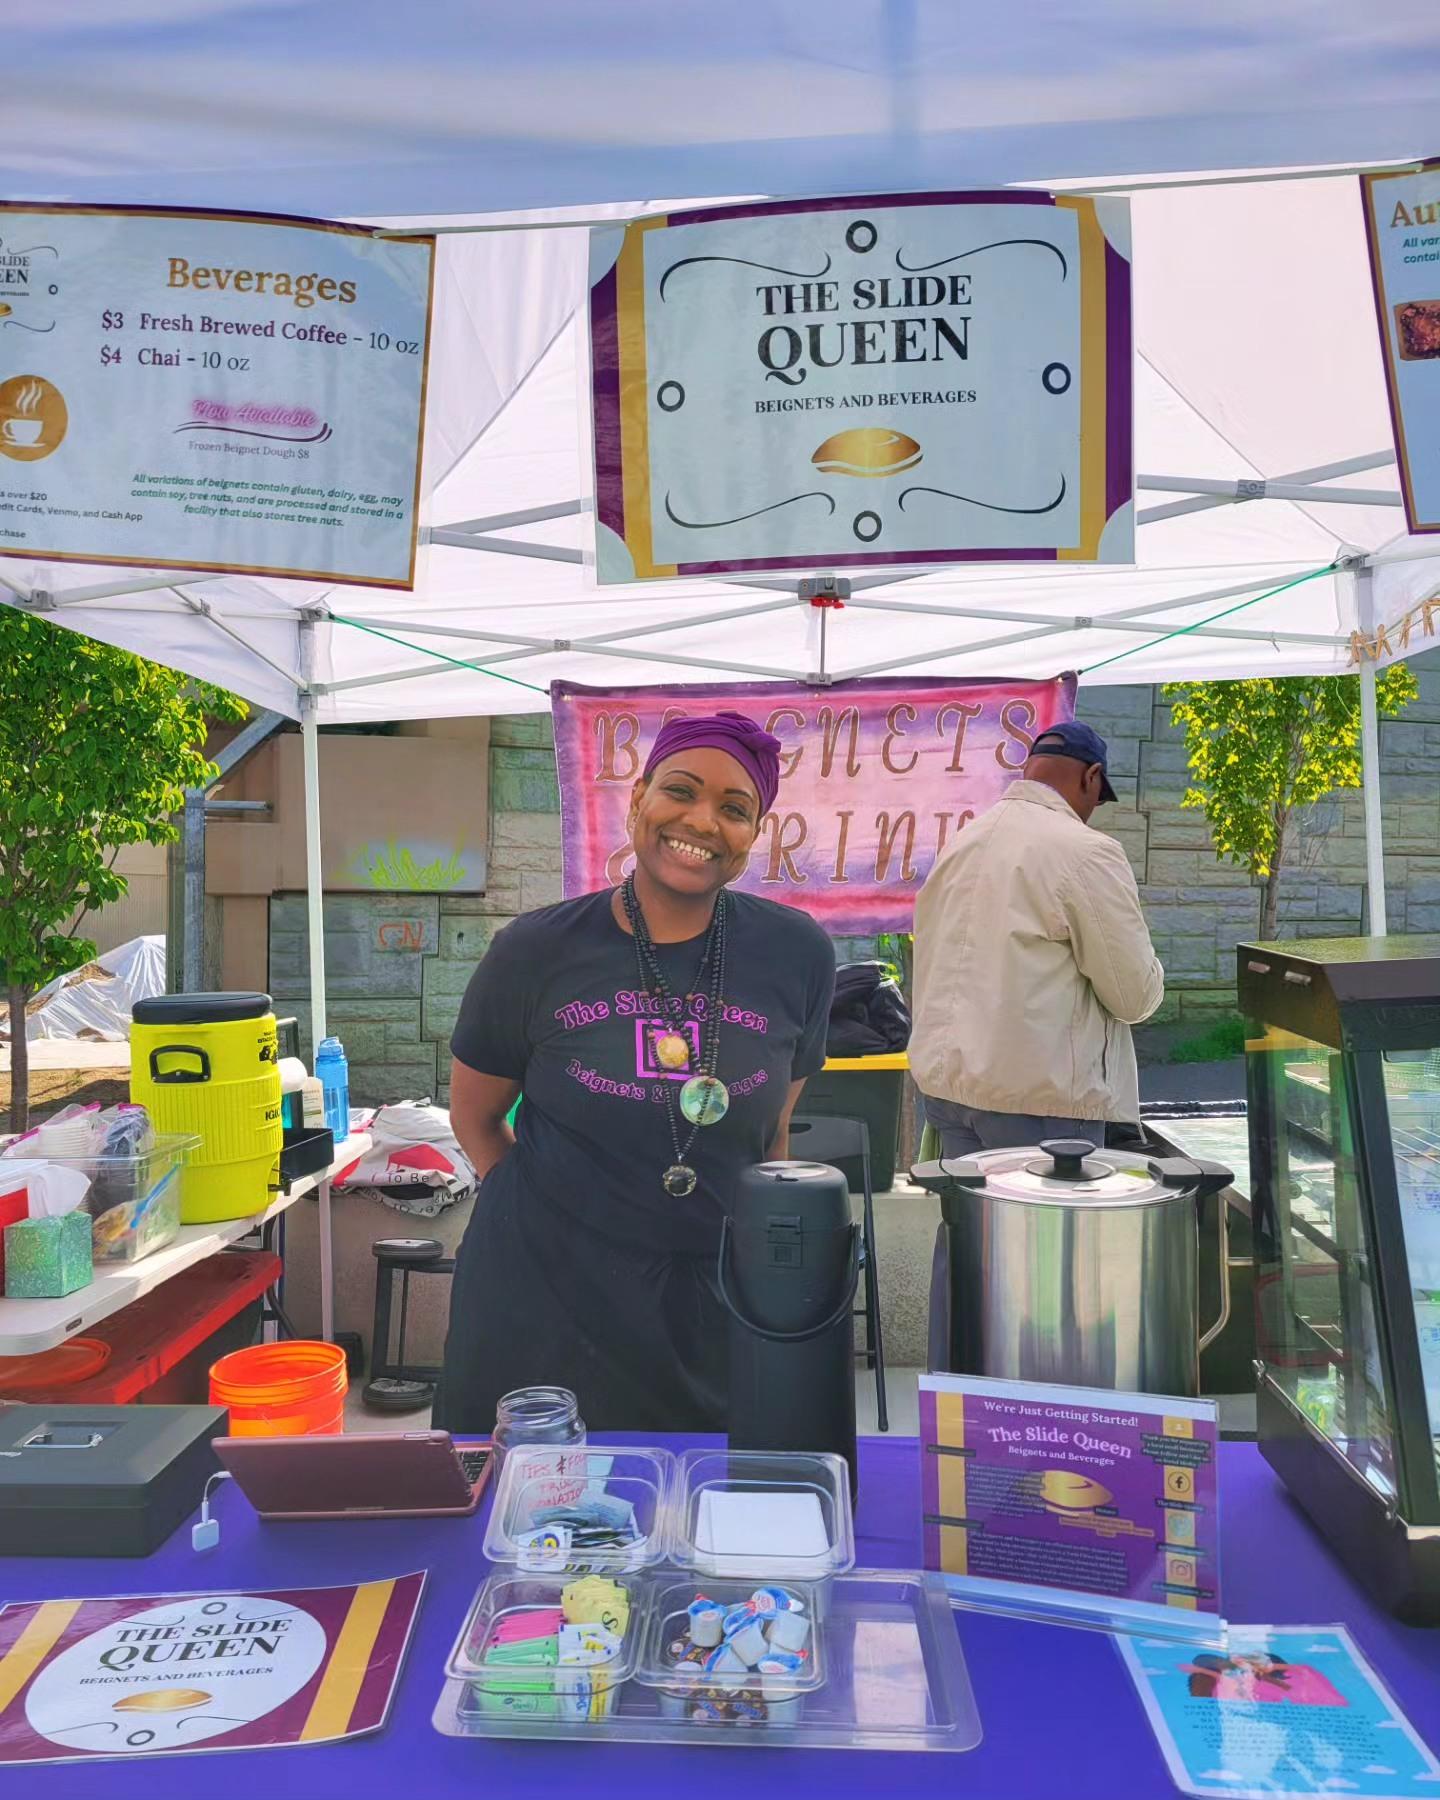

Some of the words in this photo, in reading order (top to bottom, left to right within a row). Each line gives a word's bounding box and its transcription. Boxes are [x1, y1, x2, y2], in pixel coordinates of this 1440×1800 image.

[1390, 199, 1440, 227] Au
[1402, 237, 1418, 248] All
[0, 255, 31, 267] LIDE
[167, 257, 357, 308] Beverages
[756, 281, 840, 316] THE
[852, 275, 972, 310] SLIDE
[101, 309, 124, 331] $3
[140, 313, 194, 332] Fresh
[200, 316, 275, 338] Brewed
[282, 322, 348, 345] Coffee
[369, 332, 390, 350] 10
[396, 340, 420, 355] oz
[100, 345, 122, 367] $4
[137, 348, 181, 366] Chai
[202, 351, 222, 369] 10
[227, 357, 250, 371] oz
[757, 316, 972, 386] QUEEN
[755, 396, 835, 414] BEIGNETS
[839, 394, 874, 409] AND
[878, 390, 977, 406] BEVERAGES
[188, 441, 222, 451] Frozen
[224, 443, 260, 456] Beignet
[263, 447, 296, 459] Dough
[30, 491, 48, 501] $20
[131, 489, 168, 498] contain
[190, 492, 209, 501] tree
[211, 493, 234, 503] nuts,
[237, 495, 256, 504] and
[257, 497, 274, 506] are
[275, 498, 327, 511] processed
[329, 503, 349, 514] and
[350, 505, 383, 517] stored
[385, 509, 394, 518] in
[132, 474, 146, 483] All
[148, 475, 194, 486] variations
[197, 478, 208, 487] of
[208, 479, 250, 490] beignets
[251, 482, 290, 493] contain
[291, 485, 326, 498] gluten,
[327, 488, 356, 502] dairy,
[381, 496, 403, 508] may
[0, 503, 14, 511] dit
[16, 504, 45, 515] Cards,
[48, 507, 81, 519] Venmo,
[83, 510, 100, 518] and
[101, 510, 123, 520] Cash
[125, 512, 143, 522] App
[184, 504, 218, 516] facility
[220, 507, 240, 517] that
[242, 509, 263, 519] also
[265, 512, 295, 522] stores
[298, 515, 317, 524] tree
[320, 517, 344, 527] nuts.
[593, 697, 1037, 784] BGNETS
[555, 1000, 611, 1030] The
[687, 993, 769, 1033] Qeen
[565, 1058, 646, 1101] Beignets
[410, 1172, 430, 1183] Be
[984, 1401, 1016, 1414] We're
[1018, 1405, 1042, 1418] Just
[1045, 1408, 1090, 1424] Getting
[1091, 1412, 1139, 1427] Started!
[987, 1427, 1022, 1443] The
[1025, 1426, 1069, 1444] Slide
[1073, 1432, 1132, 1459] Queen
[1008, 1445, 1048, 1457] Beignets
[1050, 1451, 1067, 1460] and
[1068, 1452, 1116, 1468] Beverages
[116, 1626, 185, 1642] THE
[192, 1619, 293, 1638] SLIDE
[97, 1635, 284, 1672] QUEEN
[79, 1674, 151, 1685] BEIGNETS
[153, 1672, 185, 1681] AND
[187, 1667, 274, 1680] BEVERAGES
